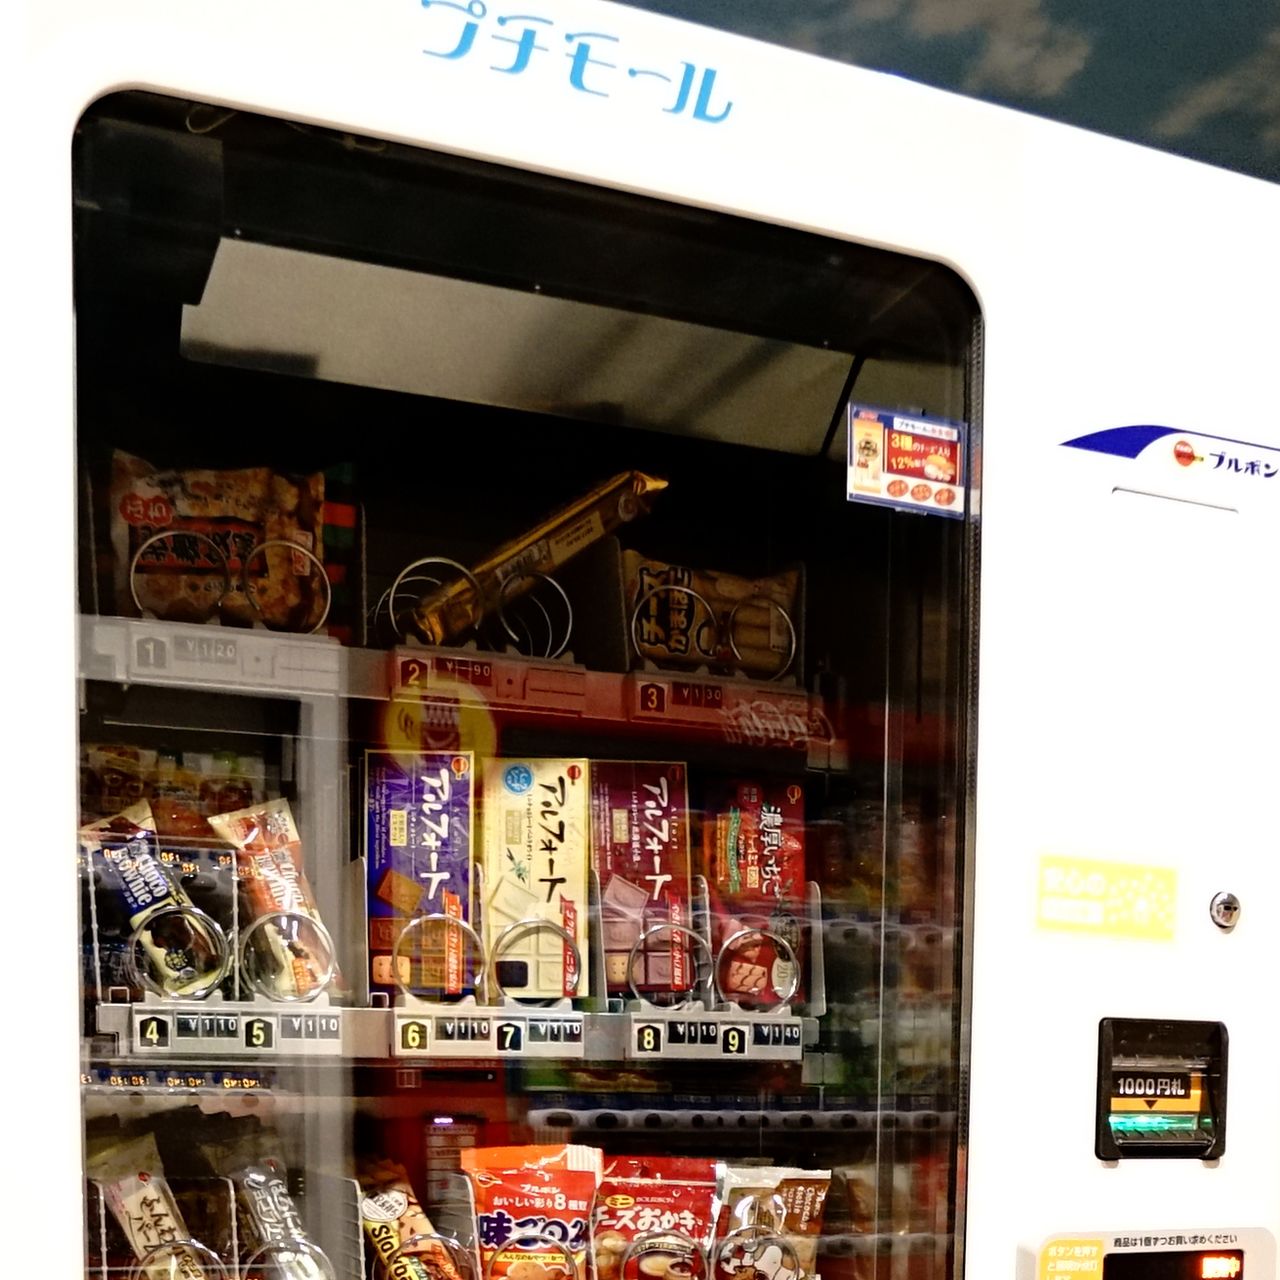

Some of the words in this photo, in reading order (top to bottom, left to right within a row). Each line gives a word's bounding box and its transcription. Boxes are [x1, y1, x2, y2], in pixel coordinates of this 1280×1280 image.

[421, 0, 733, 123] プチモール
[1209, 451, 1279, 480] ブルボン
[407, 661, 422, 686] 2
[646, 687, 659, 709] 3
[421, 768, 451, 900] アルフォート
[538, 775, 567, 903] アルフォート
[643, 776, 673, 901] アルフォート
[760, 805, 784, 899] 濃厚いちご
[137, 853, 169, 898] Choco
[145, 1020, 159, 1044] 4
[252, 1022, 265, 1046] 5
[407, 1027, 420, 1047] 6
[502, 1028, 515, 1049] 7
[644, 1028, 655, 1049] 8
[728, 1030, 740, 1051] 9
[1117, 1077, 1185, 1096] 1000円札
[1113, 1234, 1238, 1248] 商品は1個ずつお買い求めください
